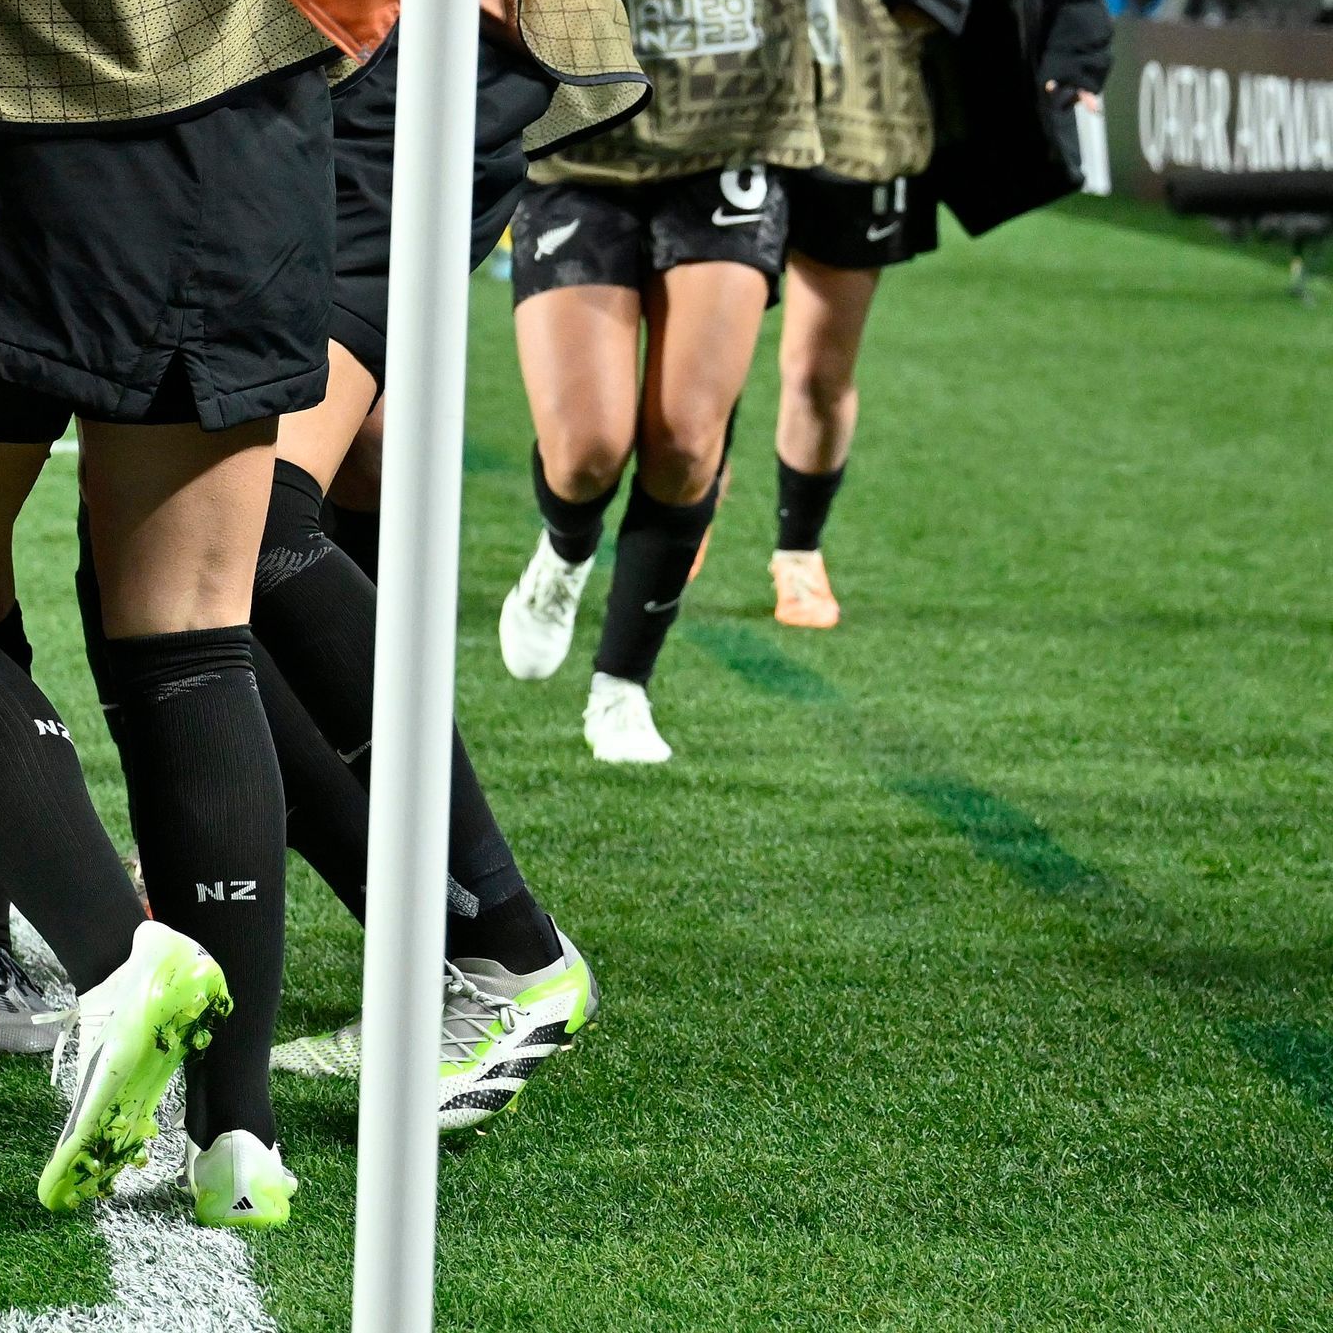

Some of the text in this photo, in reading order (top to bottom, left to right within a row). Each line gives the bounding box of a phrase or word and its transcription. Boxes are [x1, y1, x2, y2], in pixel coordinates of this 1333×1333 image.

[699, 21, 749, 44] 23
[33, 719, 75, 746] NZ
[195, 880, 257, 903] NZ
